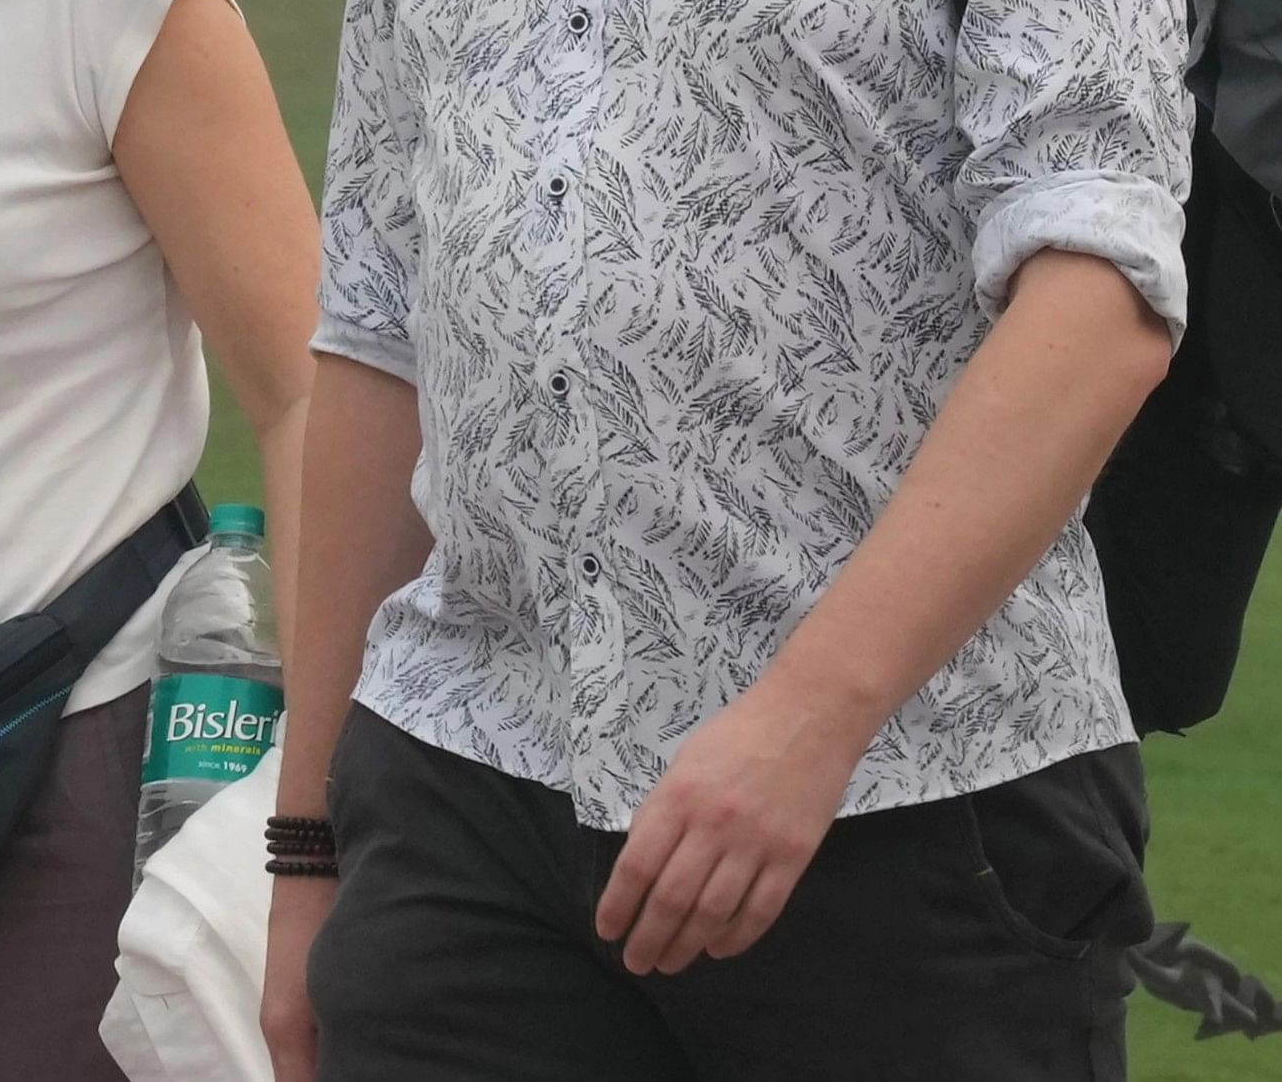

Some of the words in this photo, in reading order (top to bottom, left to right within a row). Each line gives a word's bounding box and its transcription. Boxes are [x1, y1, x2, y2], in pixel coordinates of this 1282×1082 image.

[166, 699, 279, 744] Bisleri
[211, 744, 262, 756] minerals
[223, 761, 248, 774] 1969
